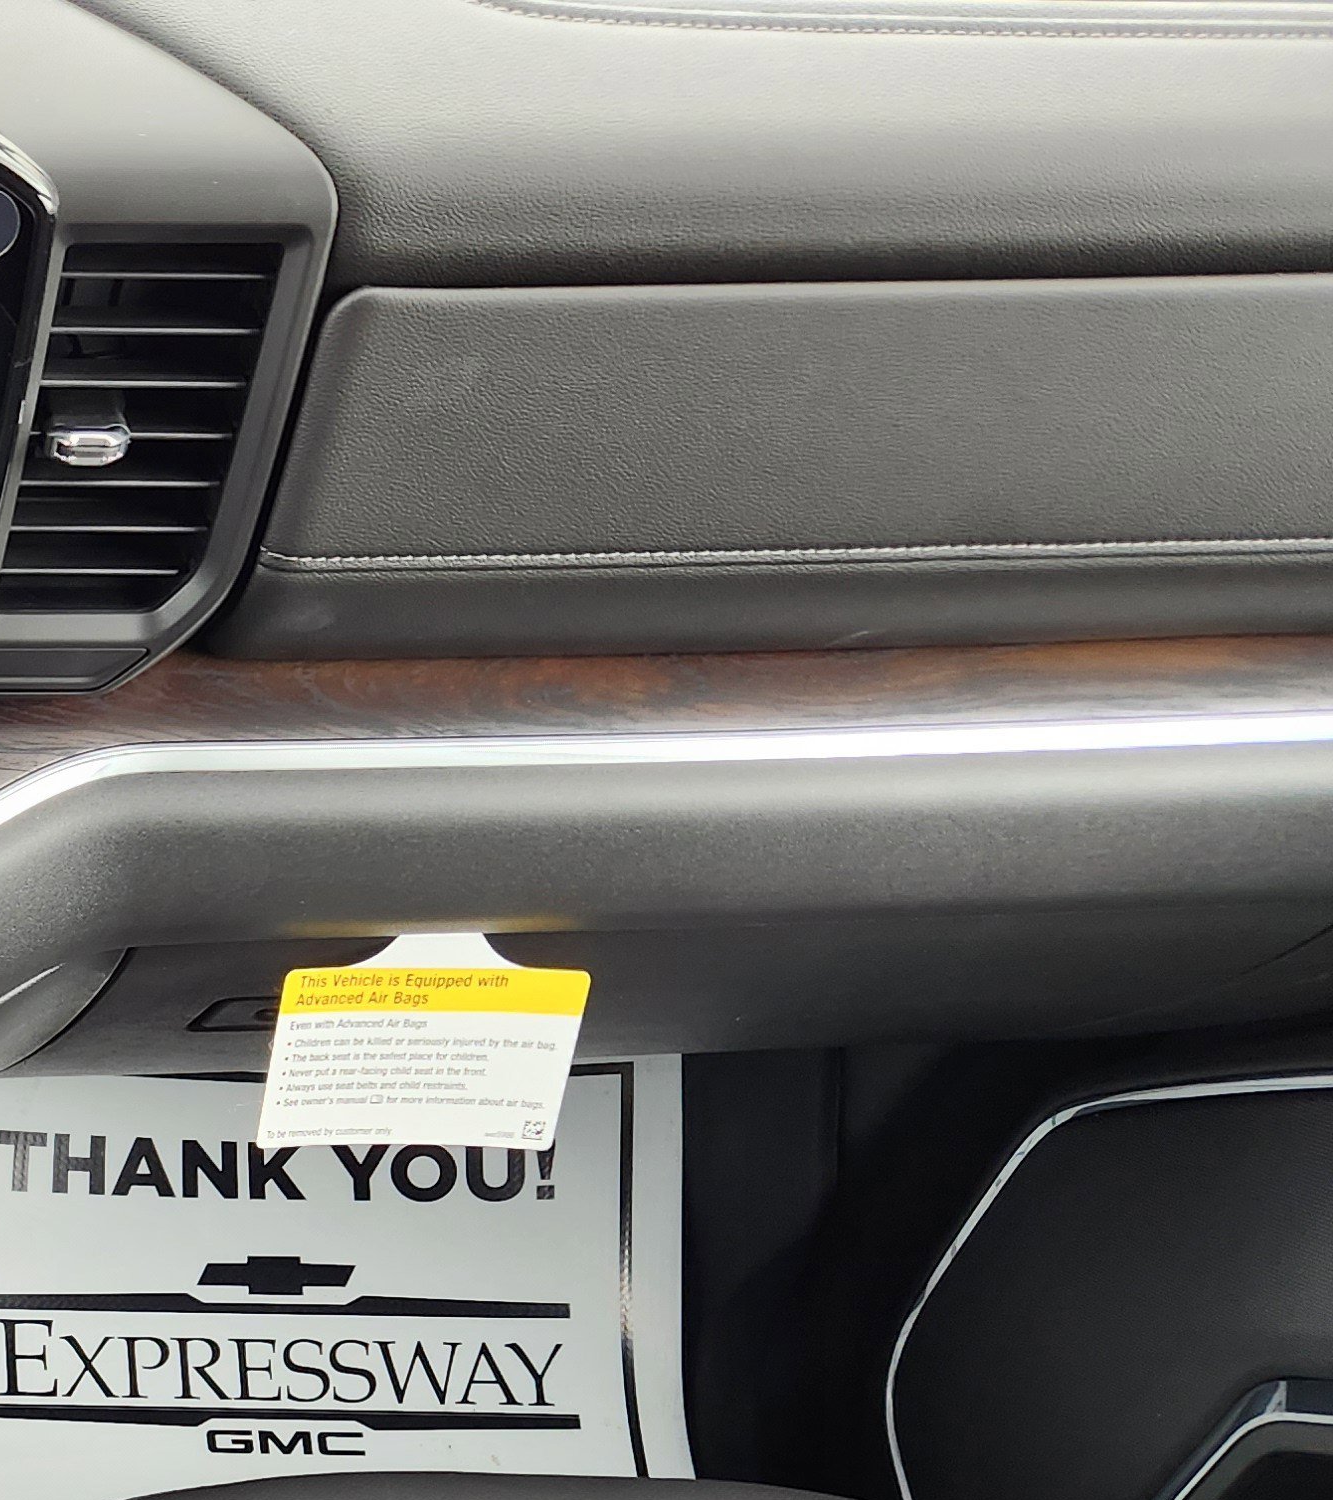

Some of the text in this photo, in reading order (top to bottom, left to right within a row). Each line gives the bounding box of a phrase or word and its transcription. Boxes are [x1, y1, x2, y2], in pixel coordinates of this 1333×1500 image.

[300, 973, 509, 989] This Vehicle is Equipped with
[296, 991, 429, 1007] Advanced Air Bags
[290, 1019, 428, 1030] Even with Advanced Air Bags
[295, 1038, 331, 1047] Children
[353, 1037, 364, 1046] be
[367, 1037, 392, 1046] killed
[489, 1038, 500, 1049] by
[503, 1038, 518, 1047] the
[521, 1040, 534, 1048] air
[293, 1053, 307, 1062] The
[330, 1138, 555, 1202] YOU!
[206, 1430, 366, 1456] GMC
